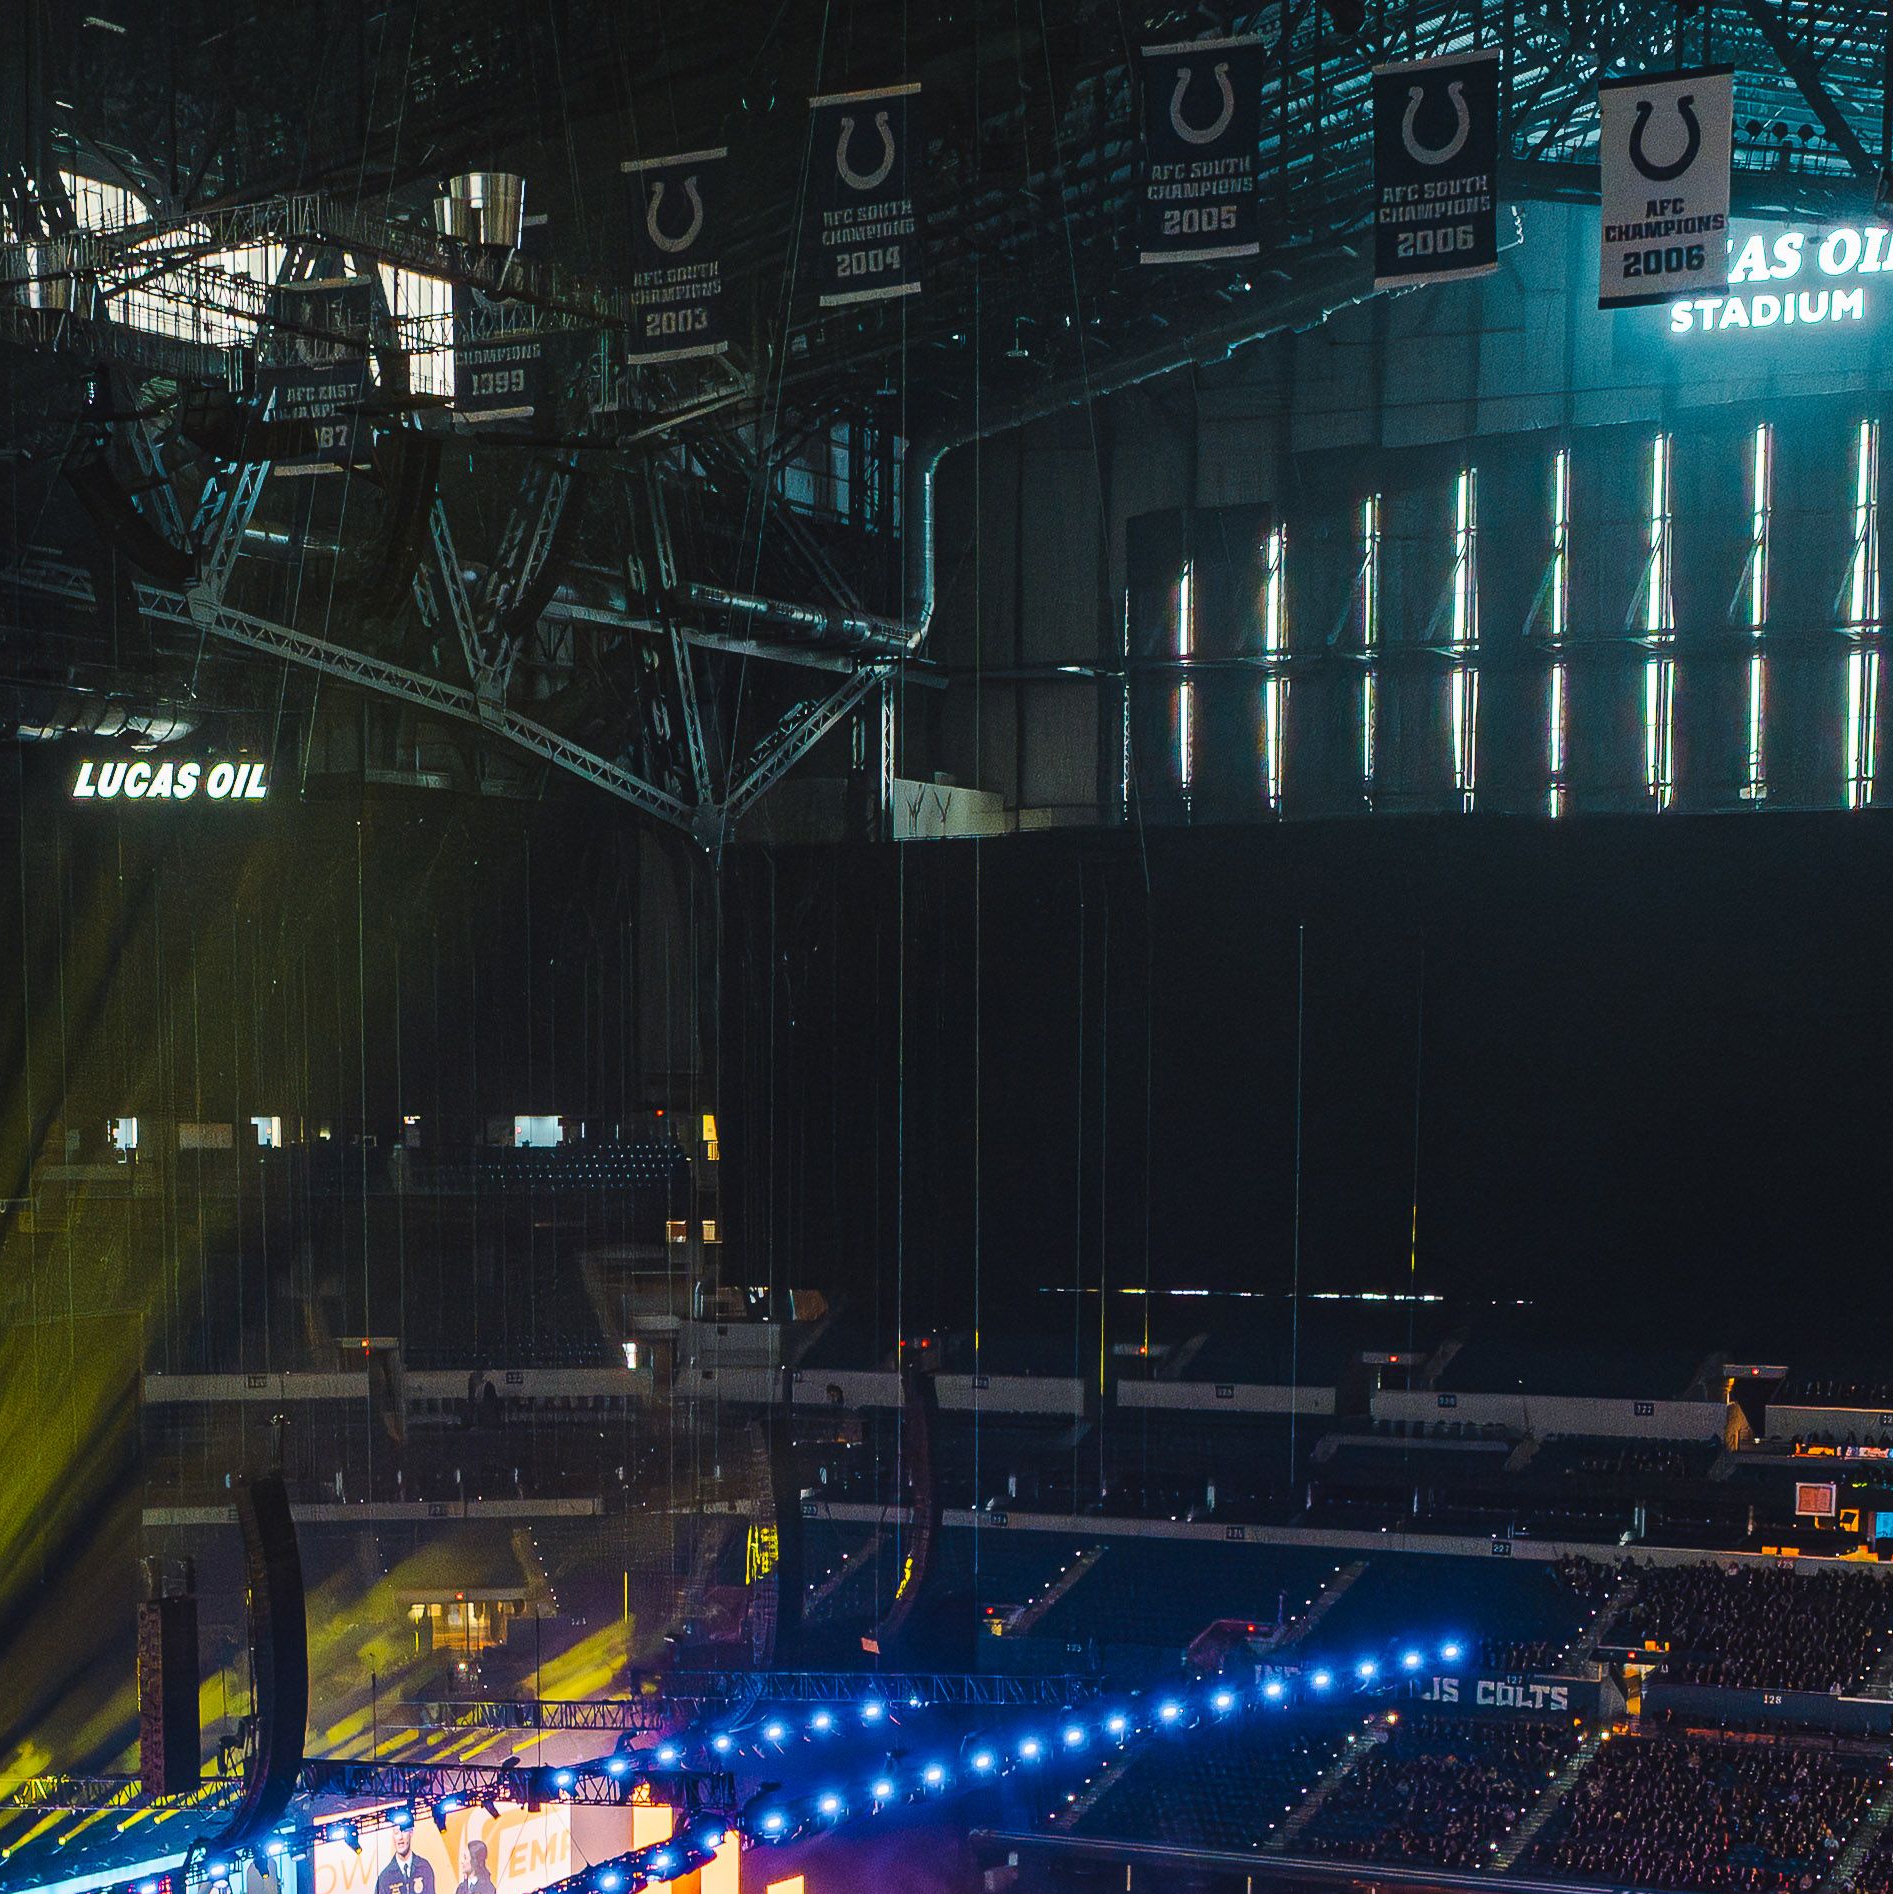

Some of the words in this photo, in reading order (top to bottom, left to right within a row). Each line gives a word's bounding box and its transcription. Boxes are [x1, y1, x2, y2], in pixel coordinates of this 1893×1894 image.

[1152, 164, 1187, 181] AFC
[1191, 156, 1251, 180] SOUTH
[1147, 177, 1253, 201] CHAMPIONS
[1382, 186, 1418, 204] AFC
[1424, 175, 1487, 200] SOUTH
[1163, 205, 1237, 235] 2005
[1379, 195, 1490, 225] CHAMPIONS
[1646, 198, 1684, 218] AFC
[1397, 225, 1474, 258] 2006
[1605, 213, 1724, 243] CHAMPIONS
[836, 246, 901, 278] 2004
[1623, 244, 1705, 279] 2006
[646, 307, 708, 336] 2003
[1670, 288, 1864, 333] STADIUM
[72, 762, 202, 799] LUCAS
[206, 762, 267, 800] OIL
[1476, 1680, 1568, 1711] COLTS
[1764, 1694, 1782, 1704] 128
